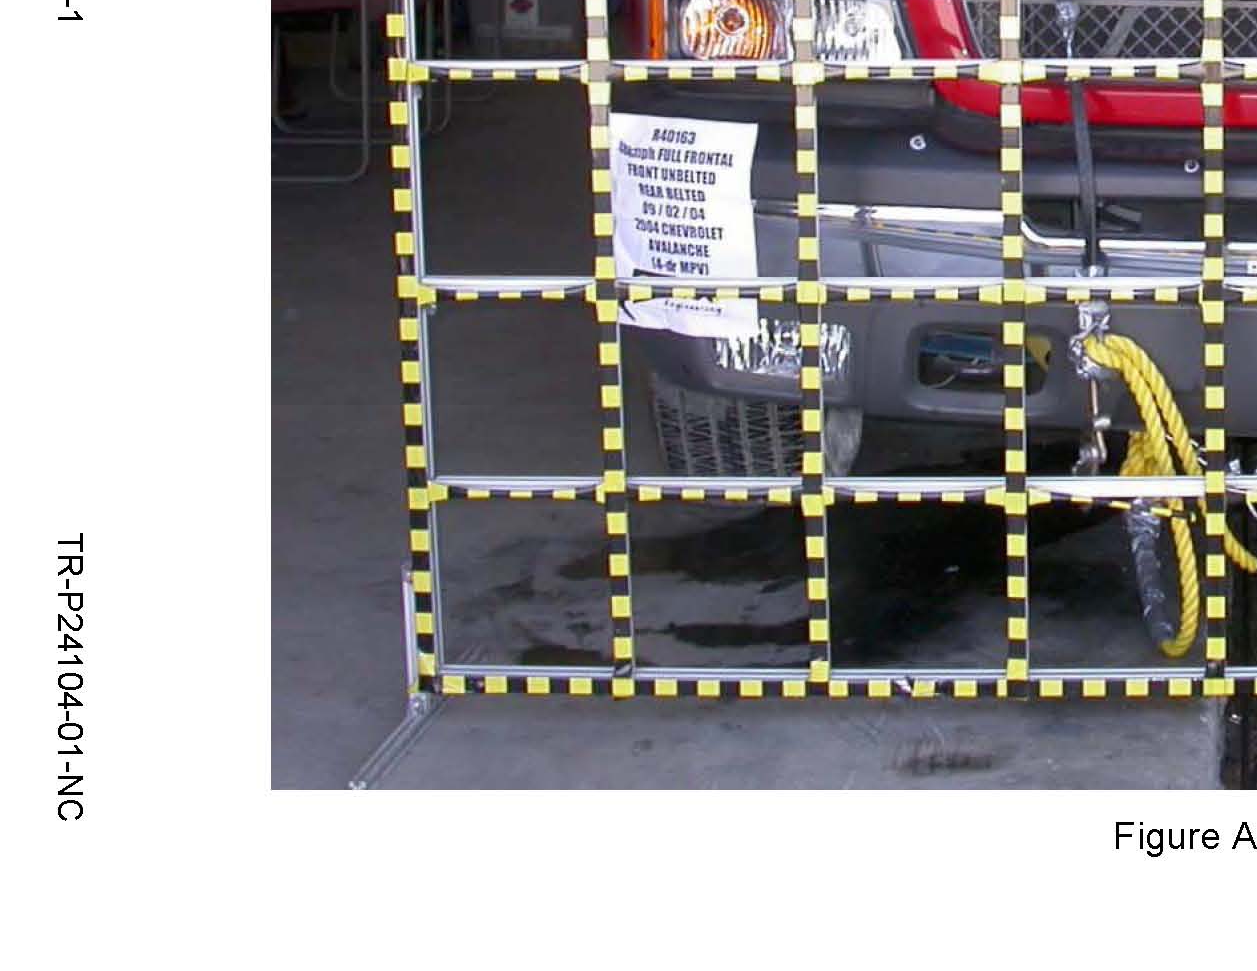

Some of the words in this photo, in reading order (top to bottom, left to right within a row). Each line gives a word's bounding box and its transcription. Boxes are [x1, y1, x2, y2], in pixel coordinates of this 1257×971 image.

[651, 128, 697, 145] R40163
[657, 148, 682, 164] FULL
[684, 150, 734, 168] FRONTAL
[627, 163, 659, 180] FRONT
[661, 167, 716, 186] UNBELTED
[638, 183, 664, 199] REAR
[666, 187, 706, 202] BELTED
[634, 217, 660, 235] 2004
[661, 222, 724, 241] CHEVROLET
[649, 239, 710, 258] AVALANCHE
